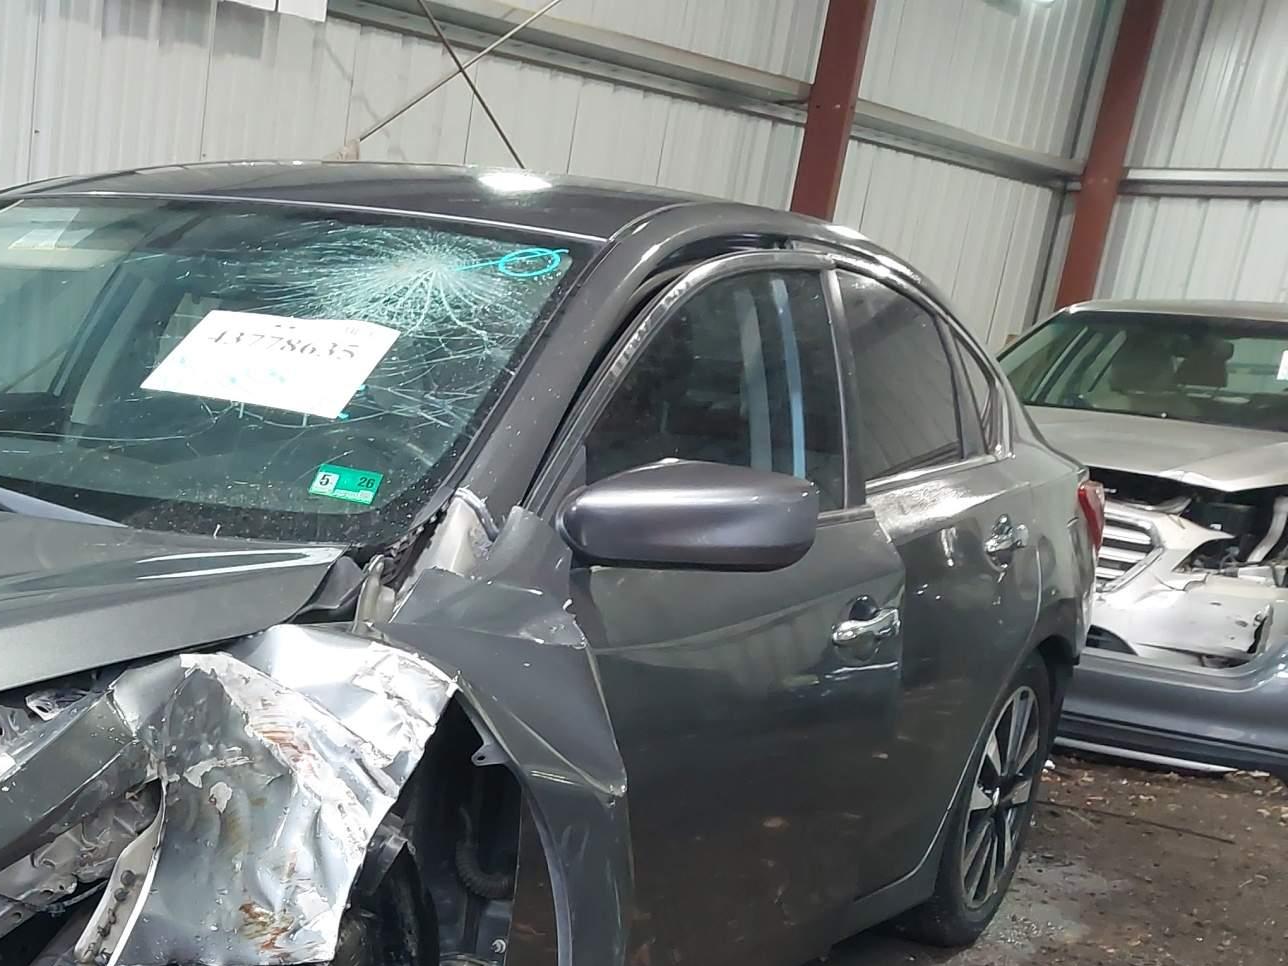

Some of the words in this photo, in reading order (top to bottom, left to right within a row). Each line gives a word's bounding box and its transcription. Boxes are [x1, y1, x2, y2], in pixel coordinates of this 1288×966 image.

[208, 329, 360, 360] 43778635
[319, 474, 333, 486] 5
[357, 476, 376, 489] 26
